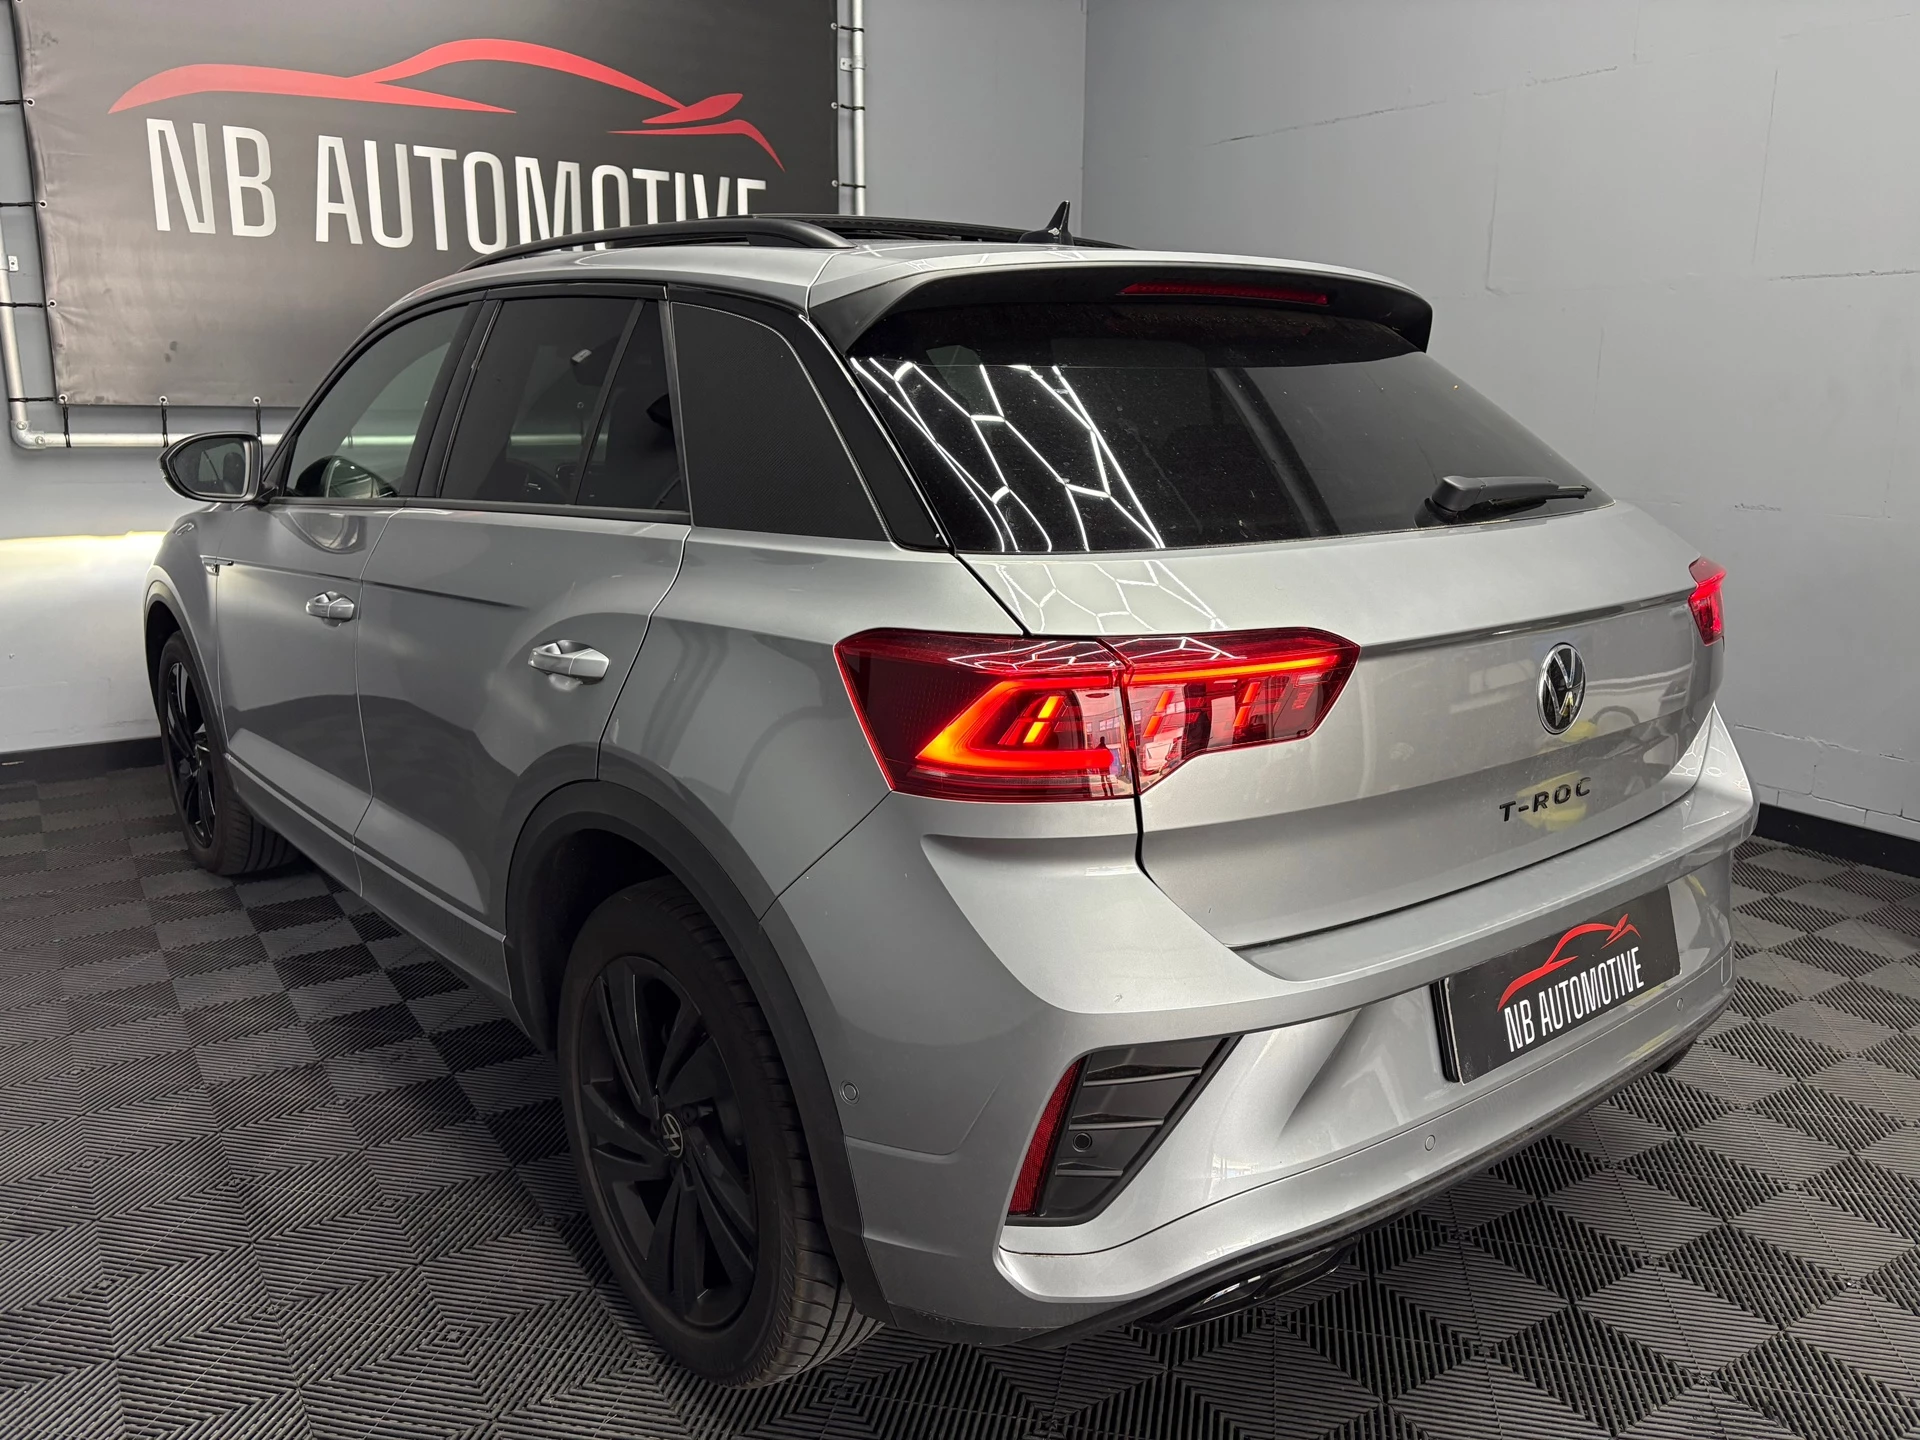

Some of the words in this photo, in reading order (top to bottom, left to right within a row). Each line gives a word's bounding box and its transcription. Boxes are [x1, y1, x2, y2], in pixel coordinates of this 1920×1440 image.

[146, 118, 276, 237] NB
[1499, 776, 1591, 822] T-ROC
[1504, 1000, 1535, 1052] NB
[1538, 946, 1645, 1036] AUTOMOTIVE
